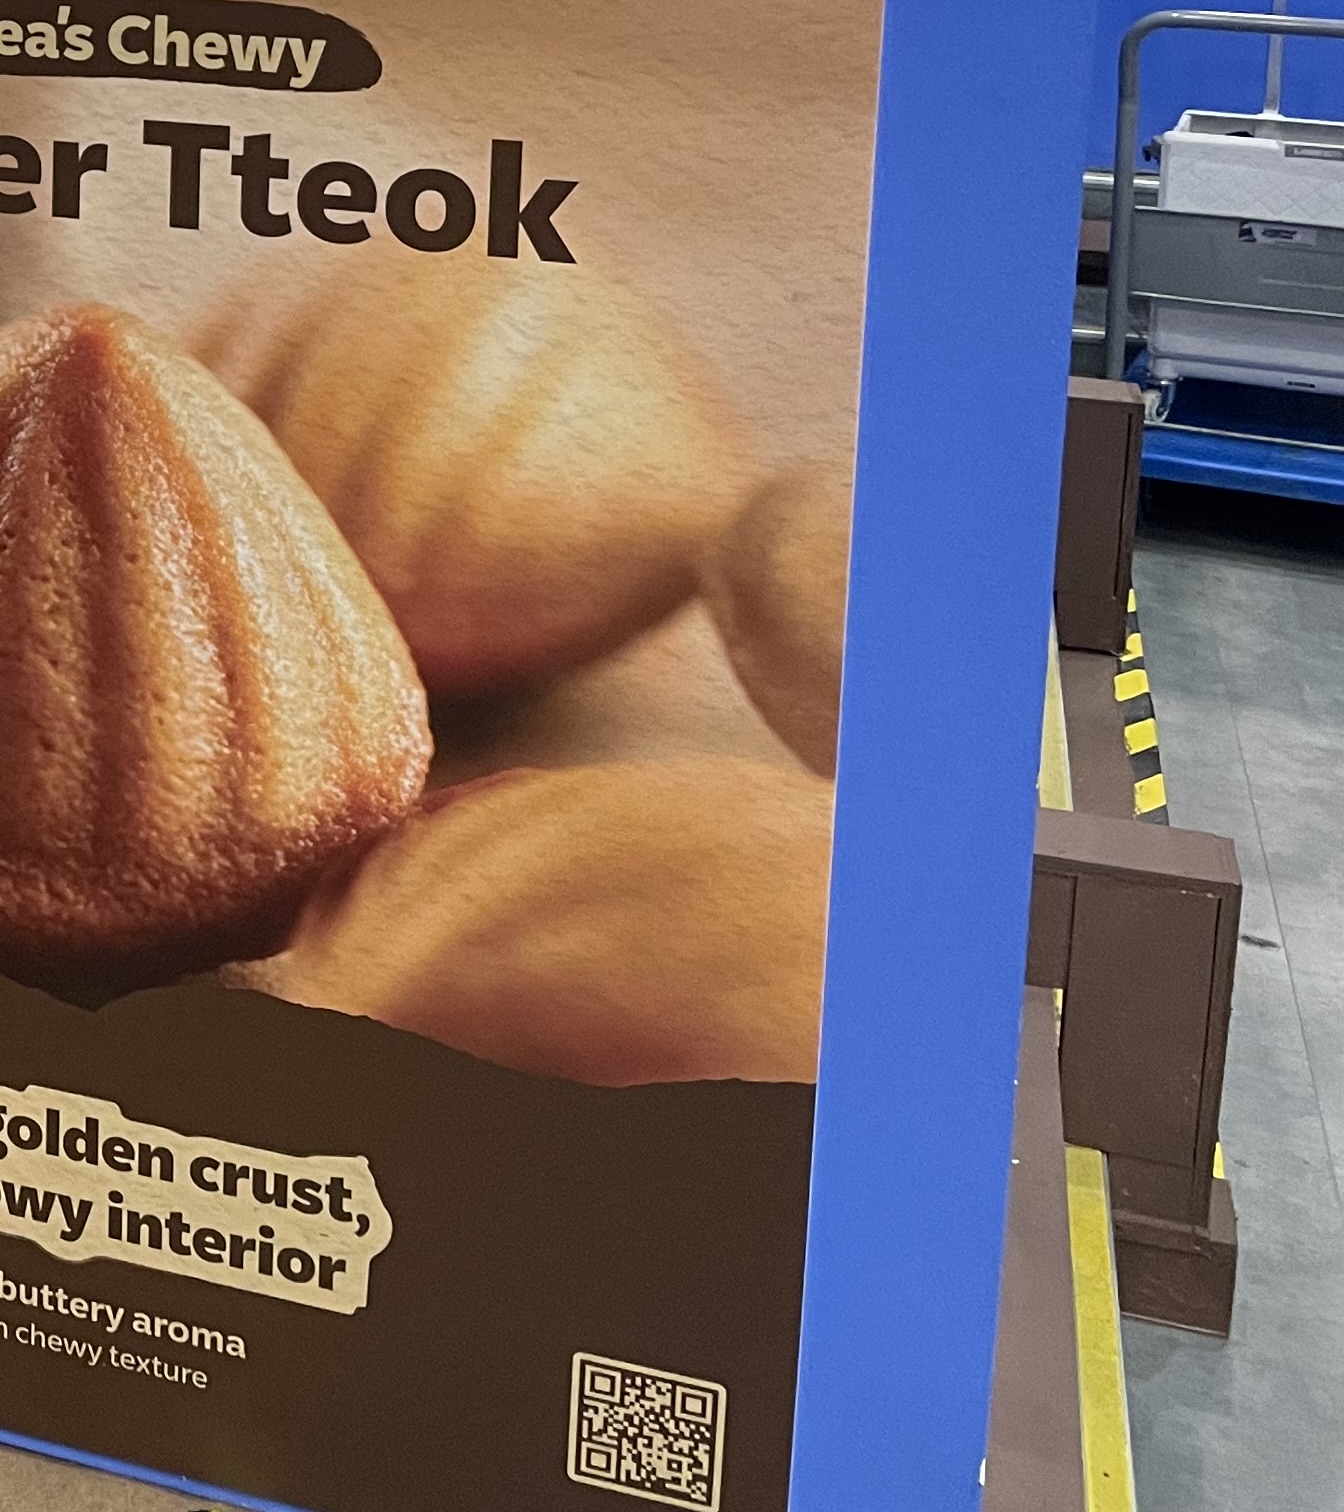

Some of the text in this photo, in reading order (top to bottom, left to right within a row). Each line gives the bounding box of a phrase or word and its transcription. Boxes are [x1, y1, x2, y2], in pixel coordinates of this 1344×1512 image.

[108, 14, 326, 90] Chewy
[143, 118, 580, 264] Tteok
[189, 1150, 373, 1237] crust,
[106, 1194, 347, 1291] interior
[14, 1323, 101, 1366] chewy
[108, 1346, 208, 1391] texture
[131, 1318, 246, 1359] aroma
